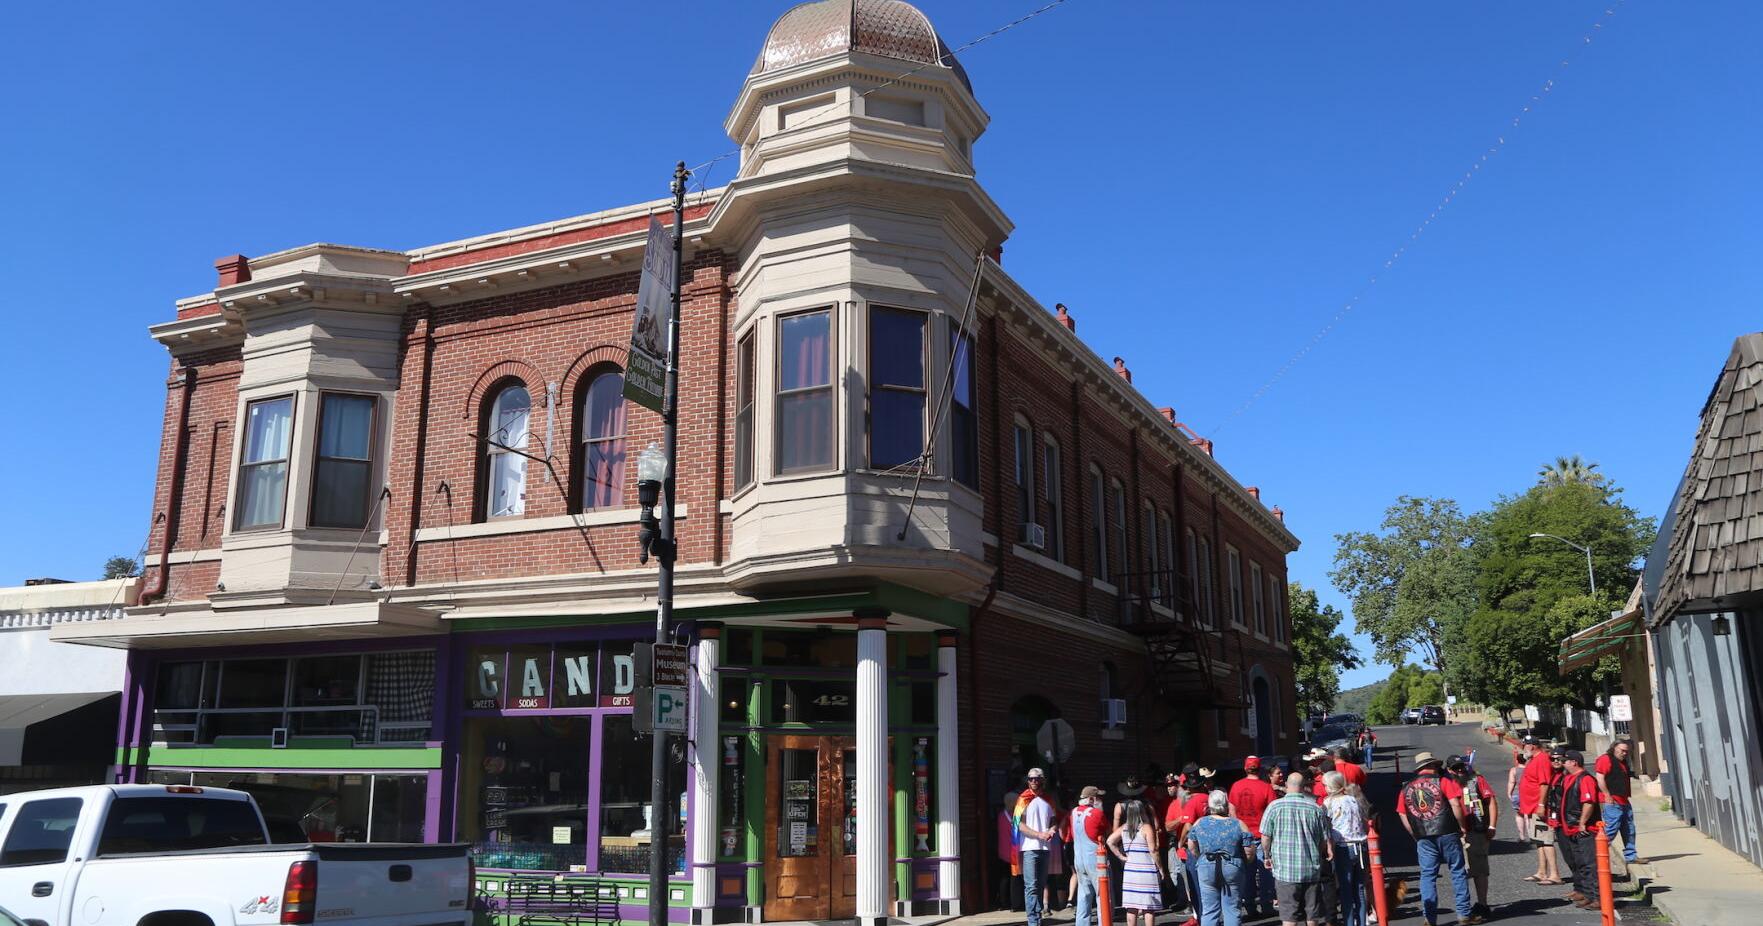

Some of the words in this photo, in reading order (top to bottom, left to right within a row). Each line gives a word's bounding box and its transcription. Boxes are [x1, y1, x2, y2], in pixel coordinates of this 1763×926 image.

[656, 659, 686, 670] Museum
[472, 700, 495, 709] SWEETS
[518, 698, 538, 708] SODAS
[612, 696, 631, 706] GIFTS
[810, 694, 849, 706] 42
